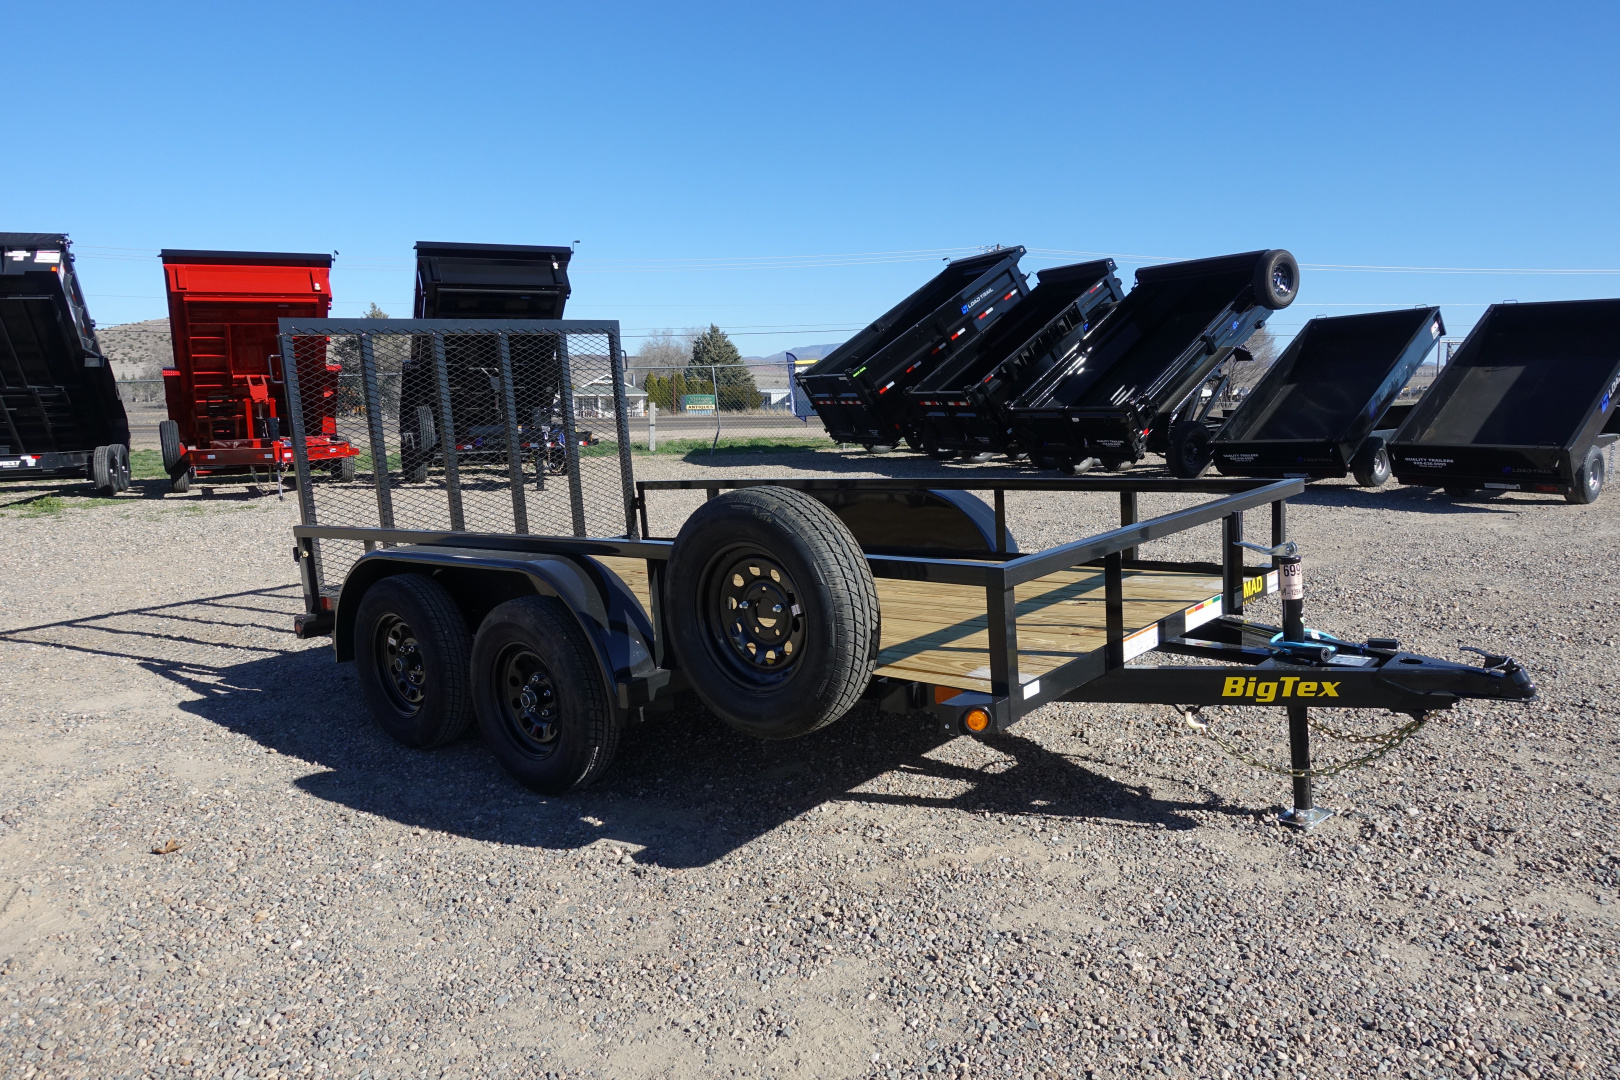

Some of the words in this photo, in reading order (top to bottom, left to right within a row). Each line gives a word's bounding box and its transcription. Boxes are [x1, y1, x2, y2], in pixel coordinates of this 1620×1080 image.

[967, 296, 981, 309] LOAD
[980, 288, 994, 299] TRAIL
[1608, 372, 1620, 399] LOA
[1221, 676, 1341, 703] BigTex
